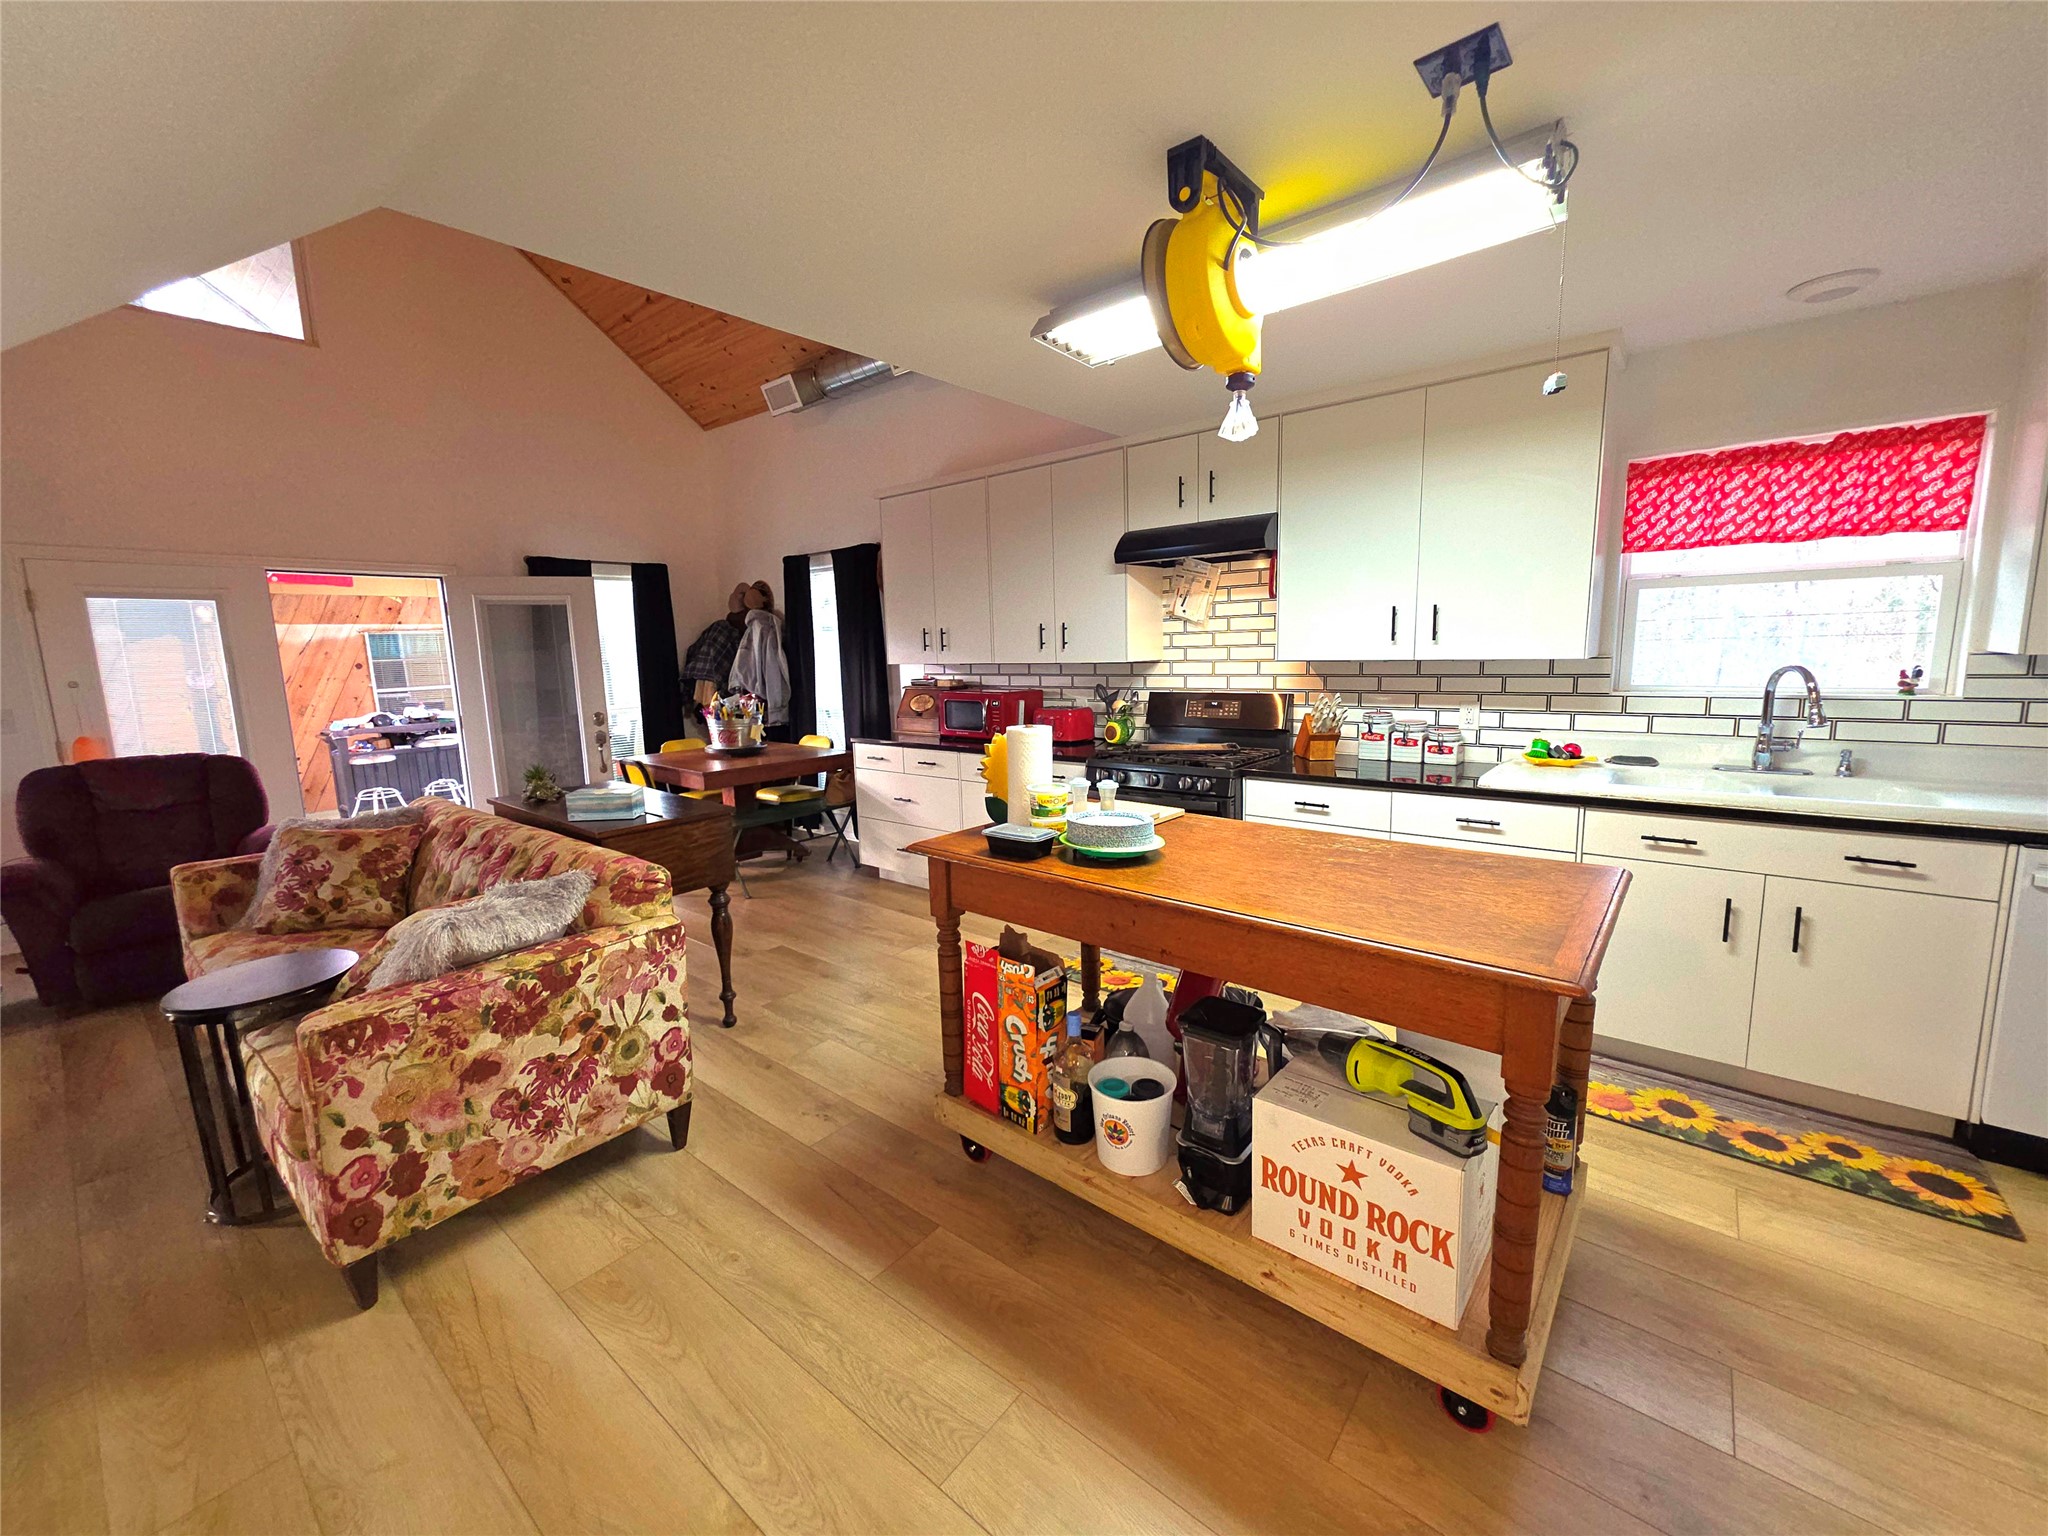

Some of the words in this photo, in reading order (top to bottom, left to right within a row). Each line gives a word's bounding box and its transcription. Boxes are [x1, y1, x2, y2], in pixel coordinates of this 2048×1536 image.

[1000, 960, 1035, 978] Crush
[972, 992, 995, 1092] Coca-Cola
[1006, 1015, 1032, 1083] Crush
[1402, 1047, 1430, 1061] RYOBI
[1291, 1136, 1326, 1153] TEXAS
[1331, 1137, 1372, 1159] CRAFT
[1380, 1157, 1418, 1197] VODKA
[1261, 1156, 1359, 1222] ROUND
[1366, 1201, 1456, 1268] ROCK
[1298, 1208, 1408, 1274] VODKA
[1289, 1228, 1295, 1238] 6
[1302, 1235, 1340, 1258] TIMES
[1347, 1254, 1418, 1294] DISTILLED
